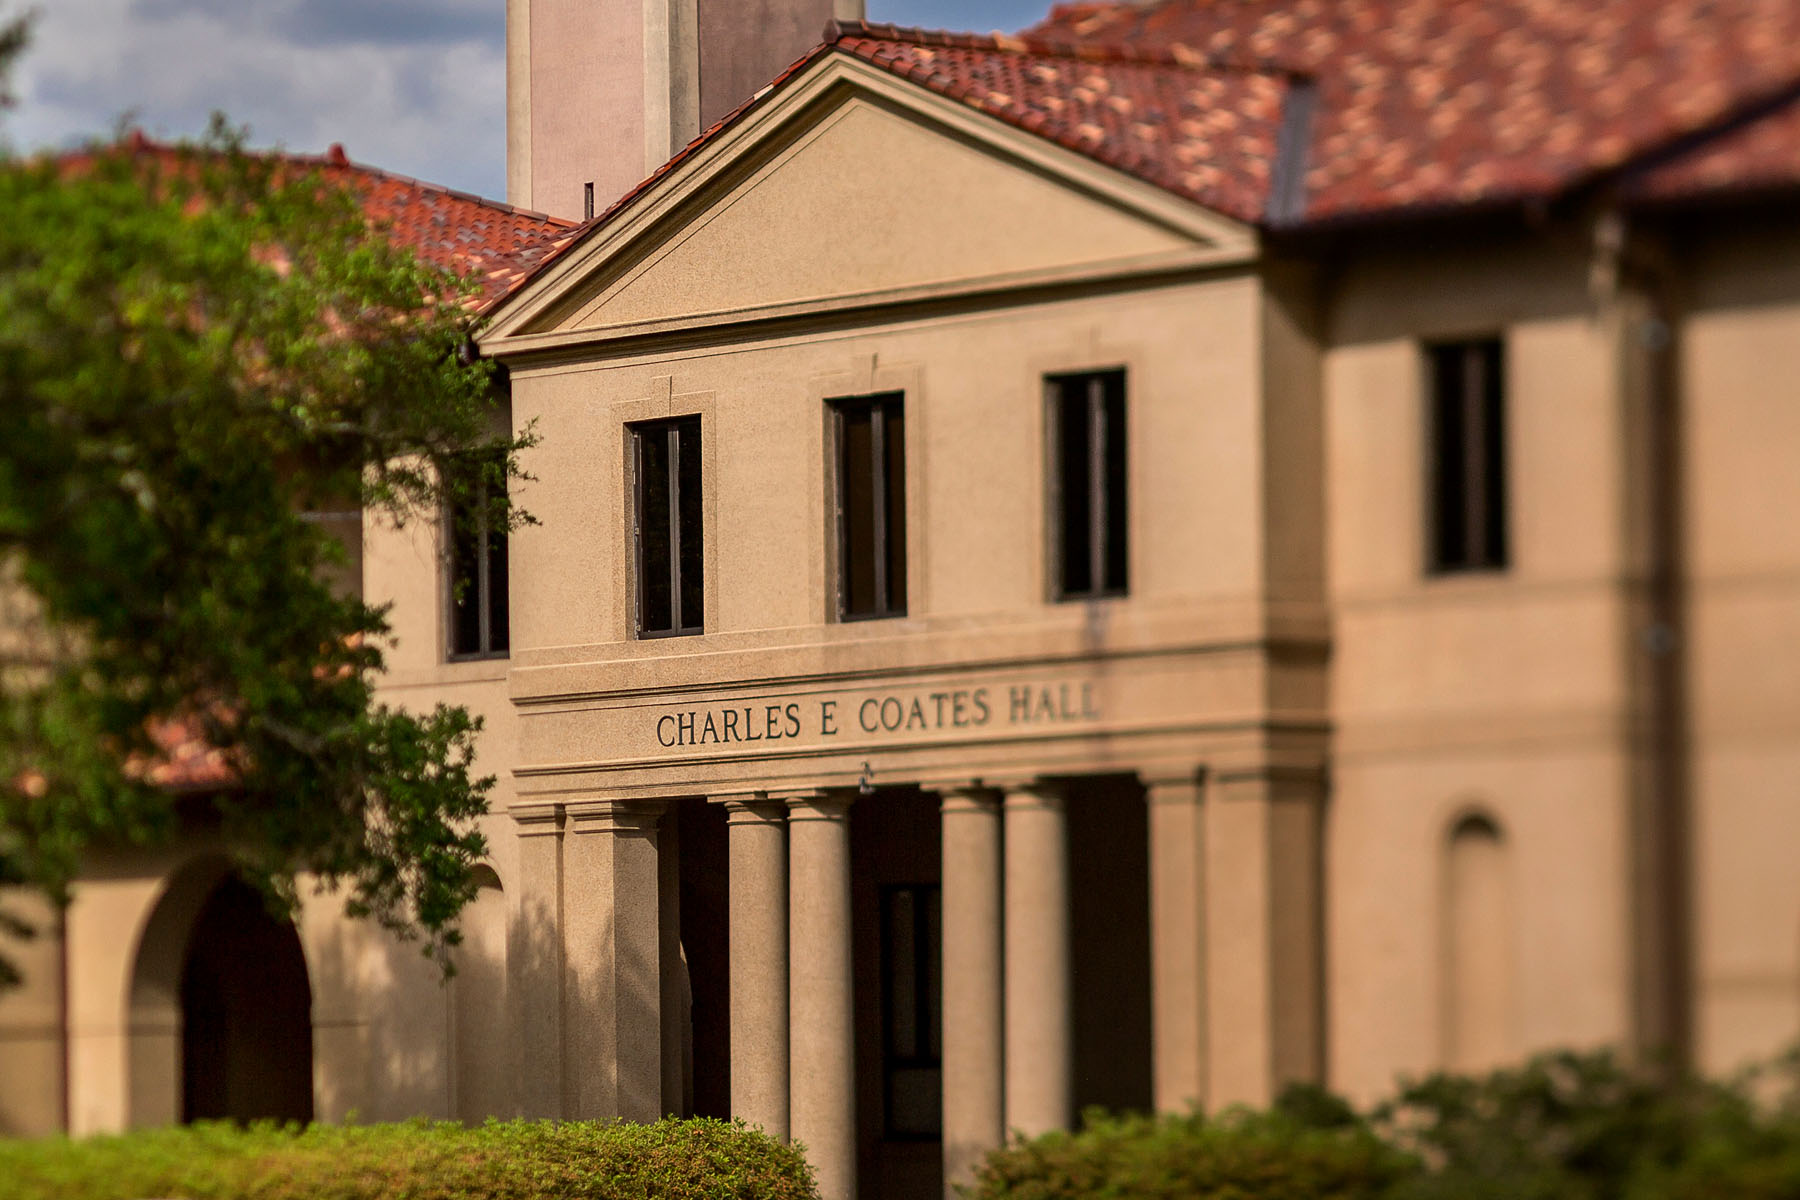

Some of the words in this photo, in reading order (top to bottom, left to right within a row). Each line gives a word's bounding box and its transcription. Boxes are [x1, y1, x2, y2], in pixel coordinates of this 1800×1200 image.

[657, 703, 801, 747] CHARLES
[819, 701, 838, 736] E
[859, 688, 990, 733] COATES
[1008, 683, 1101, 725] HALL
